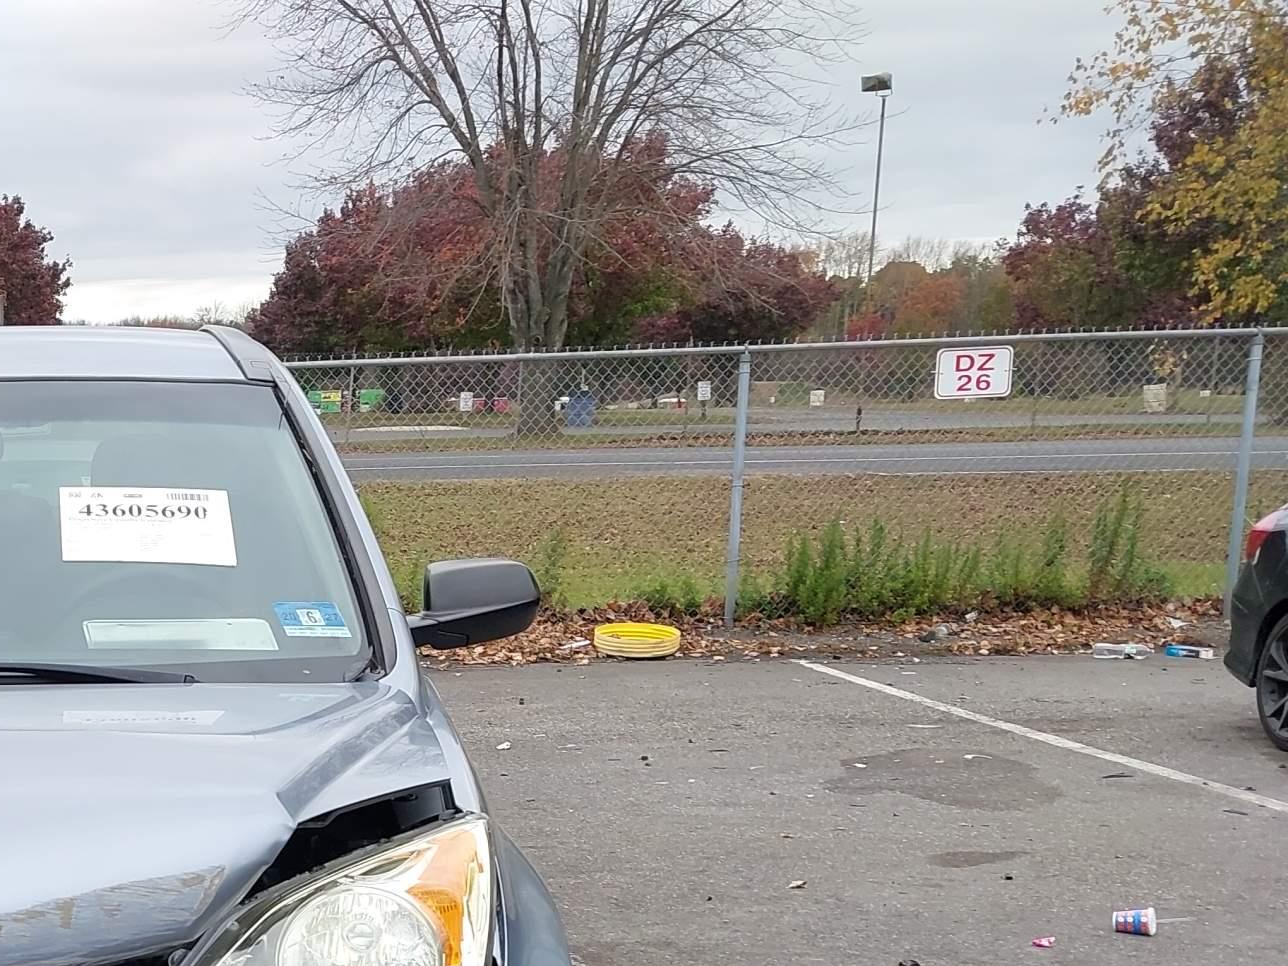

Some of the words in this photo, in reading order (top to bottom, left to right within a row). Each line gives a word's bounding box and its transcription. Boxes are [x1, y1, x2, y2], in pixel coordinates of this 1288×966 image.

[955, 353, 995, 372] DZ
[956, 374, 991, 392] 26
[78, 503, 208, 520] 43605690
[306, 611, 317, 624] 6
